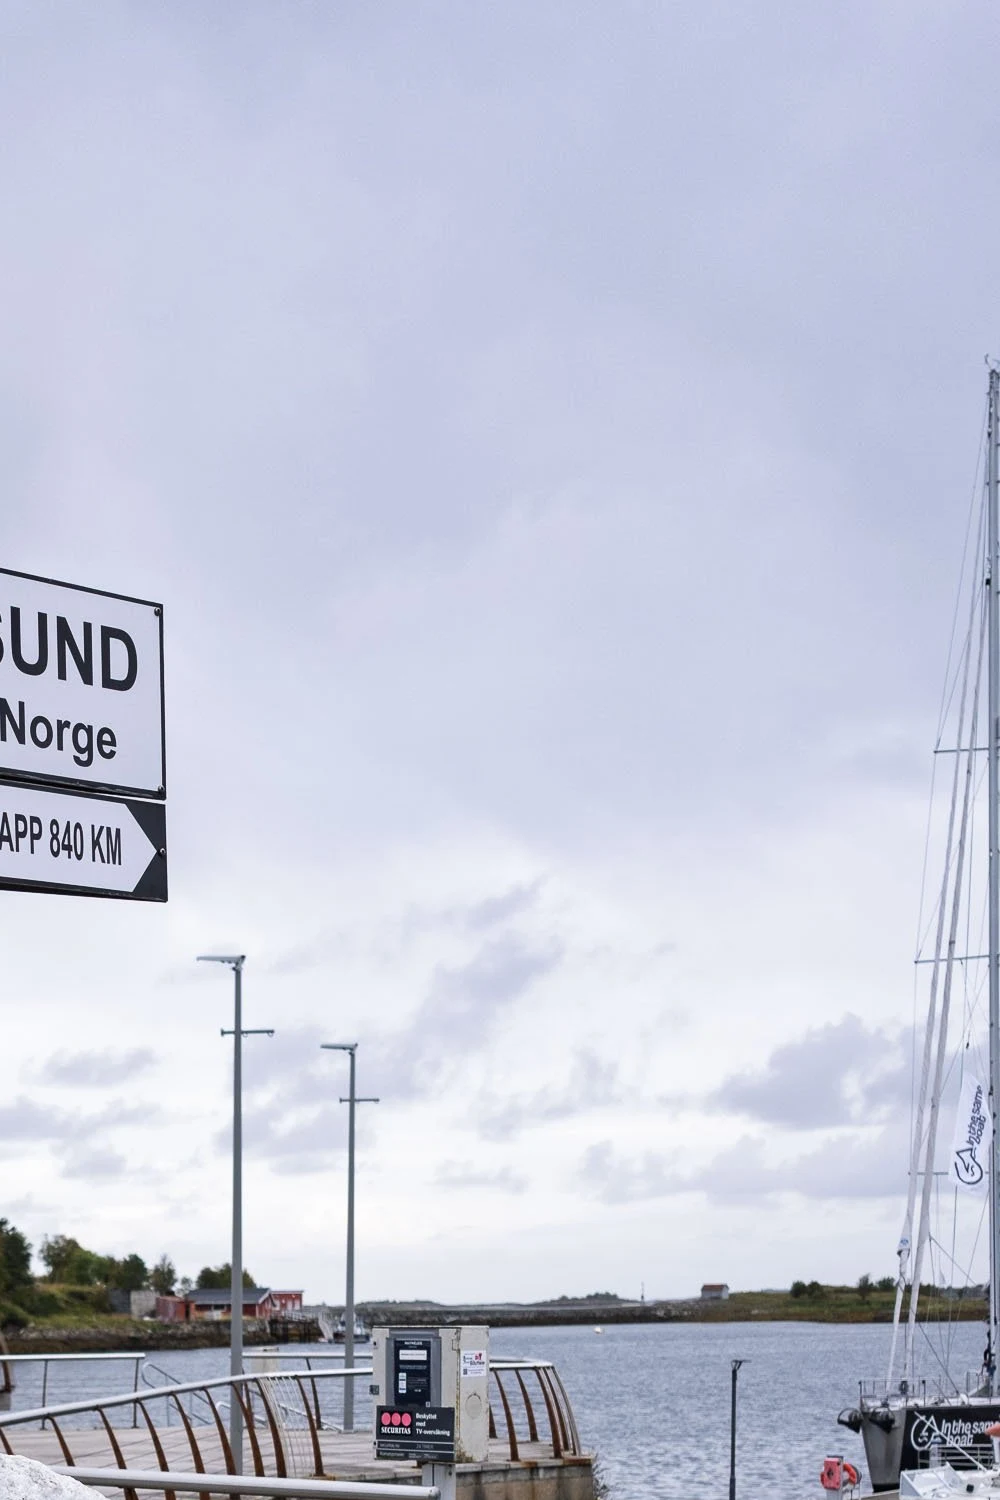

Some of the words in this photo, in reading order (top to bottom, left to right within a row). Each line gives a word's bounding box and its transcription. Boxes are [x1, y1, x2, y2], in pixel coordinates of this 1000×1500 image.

[0, 697, 117, 768] Norge
[49, 818, 84, 861] 840
[91, 824, 122, 866] KM
[967, 1114, 978, 1135] the
[381, 1427, 411, 1435] SECURITAS
[941, 1419, 951, 1434] In
[952, 1418, 972, 1434] the
[972, 1421, 995, 1434] sam
